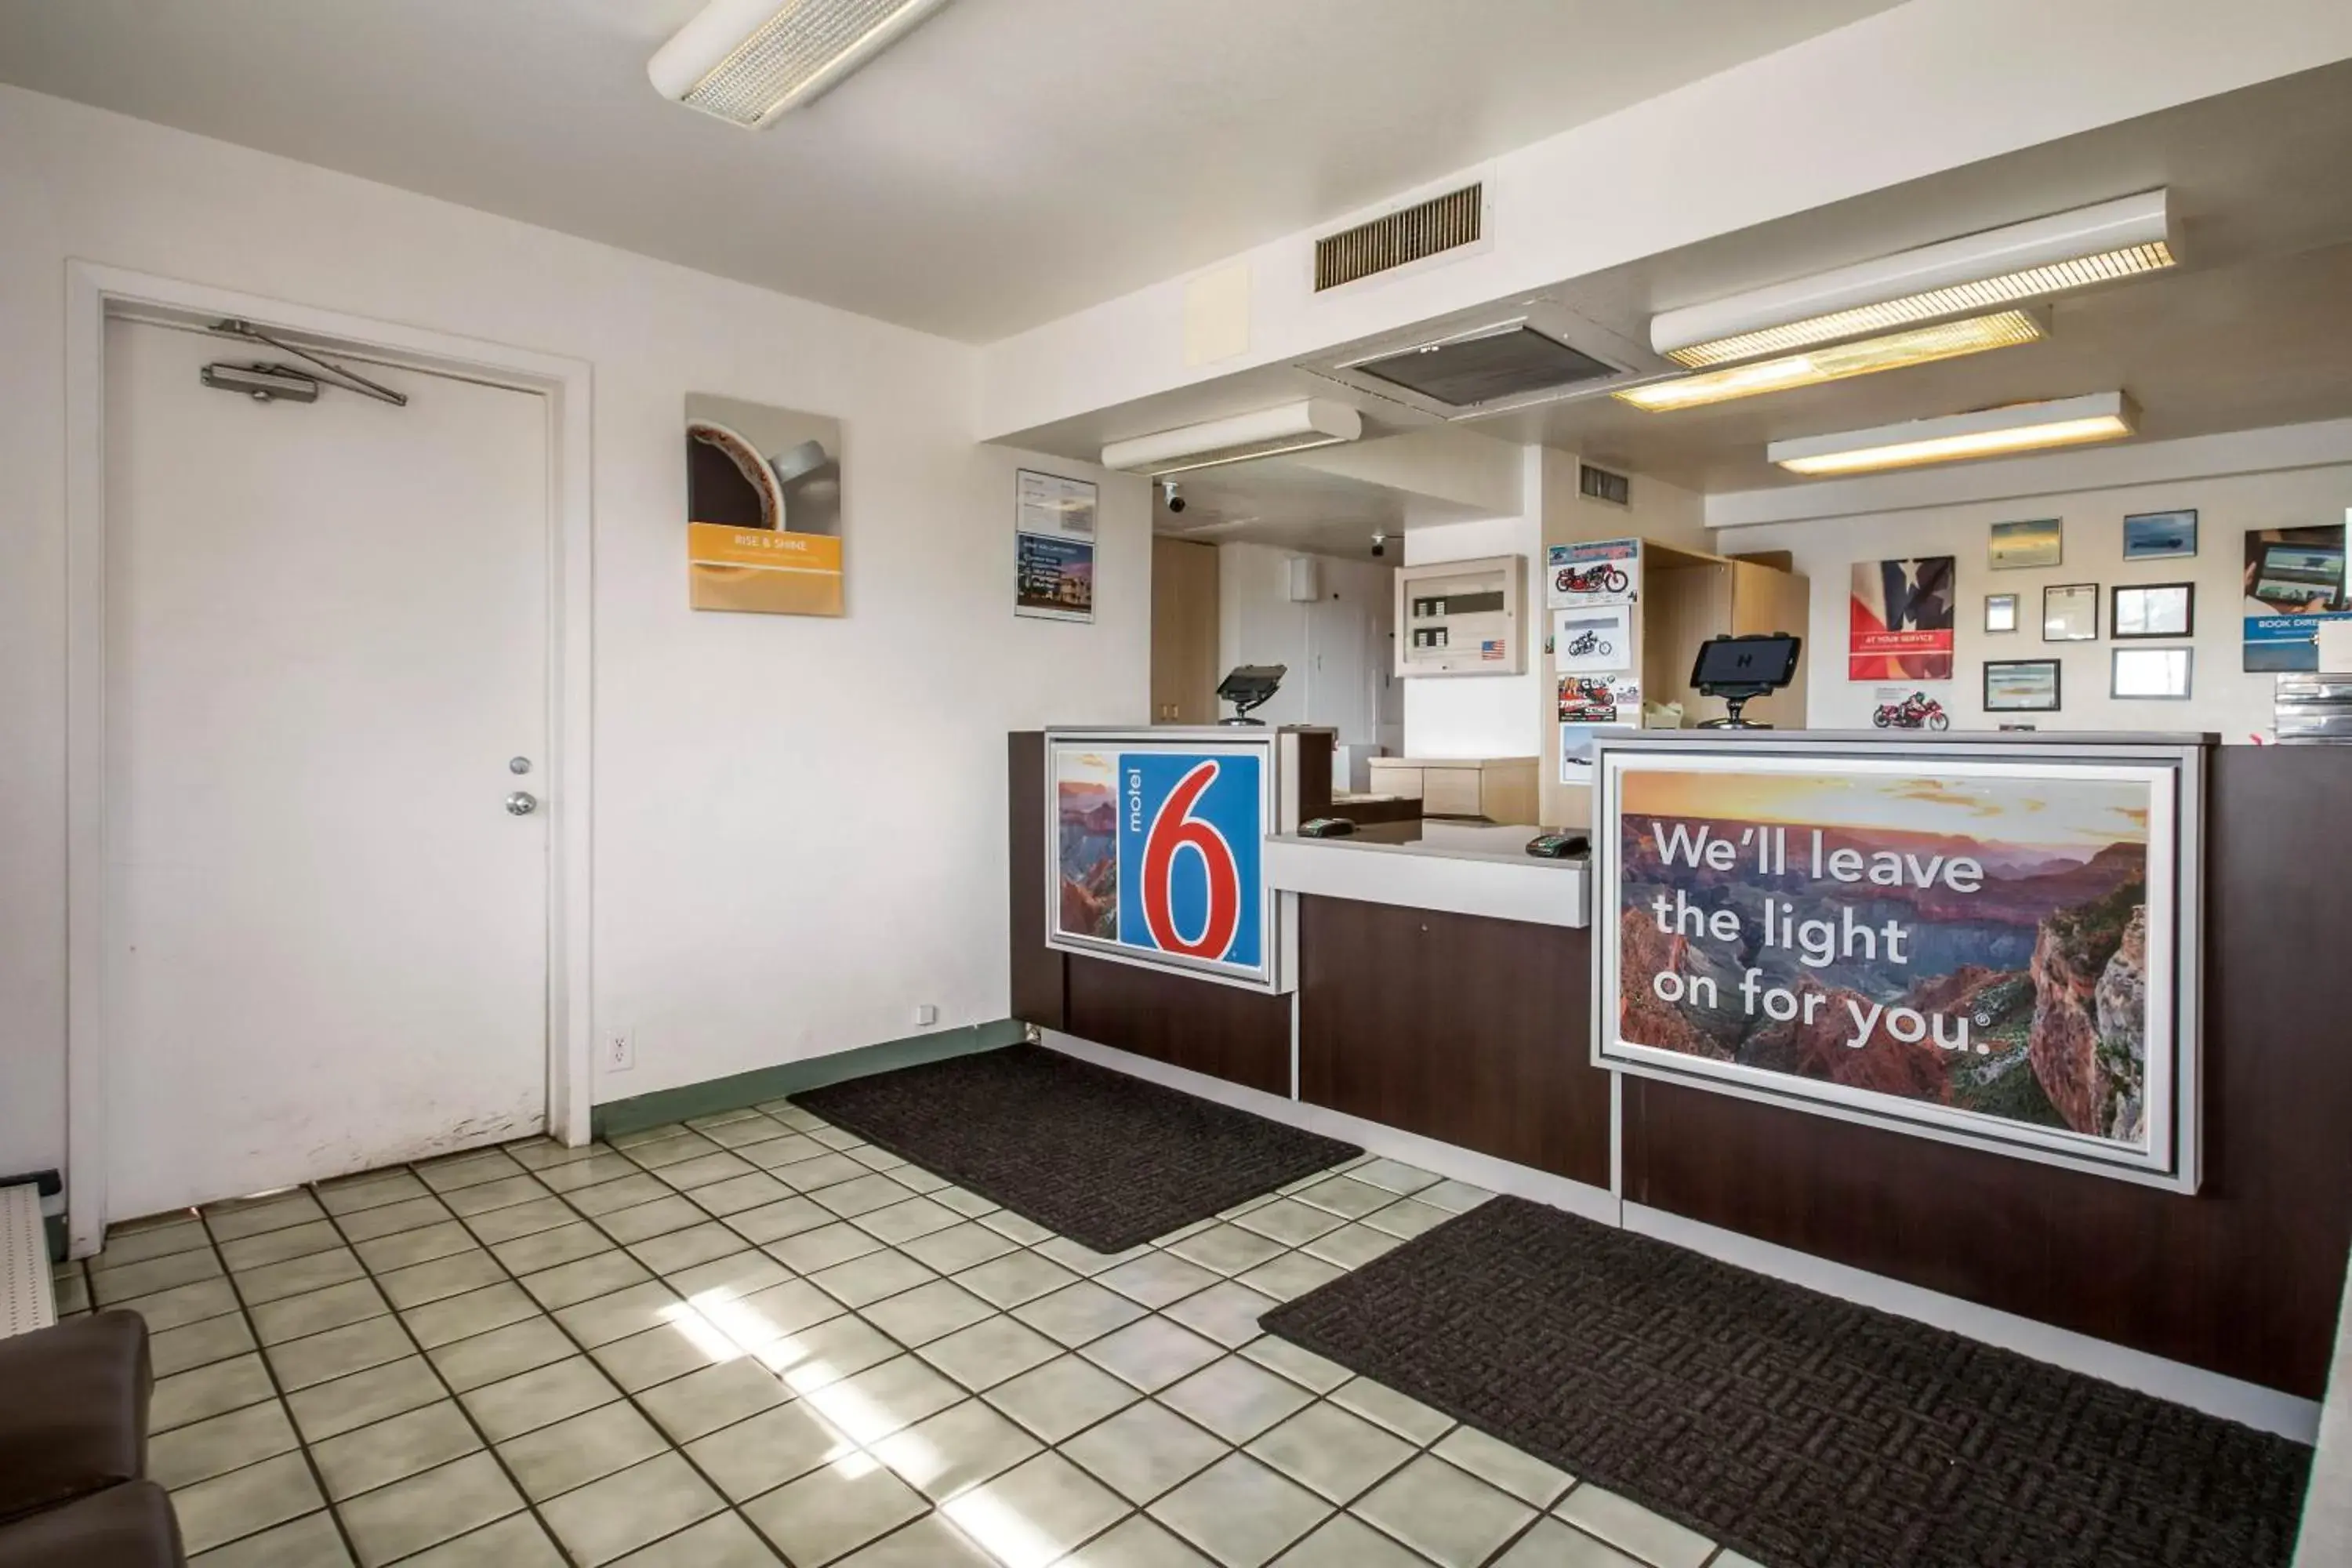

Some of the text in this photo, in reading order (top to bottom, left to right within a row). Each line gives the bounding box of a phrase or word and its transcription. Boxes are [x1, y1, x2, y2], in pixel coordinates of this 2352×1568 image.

[735, 534, 760, 546] RISE
[774, 538, 808, 552] SHINE
[1900, 633, 1934, 642] SERVICE
[2259, 619, 2290, 628] BOOK
[1127, 768, 1142, 833] motel
[1141, 759, 1241, 961] 6
[1811, 829, 1984, 893] leave
[1652, 888, 1909, 968] the light
[1653, 969, 1718, 1010] on
[1738, 967, 1828, 1025] for
